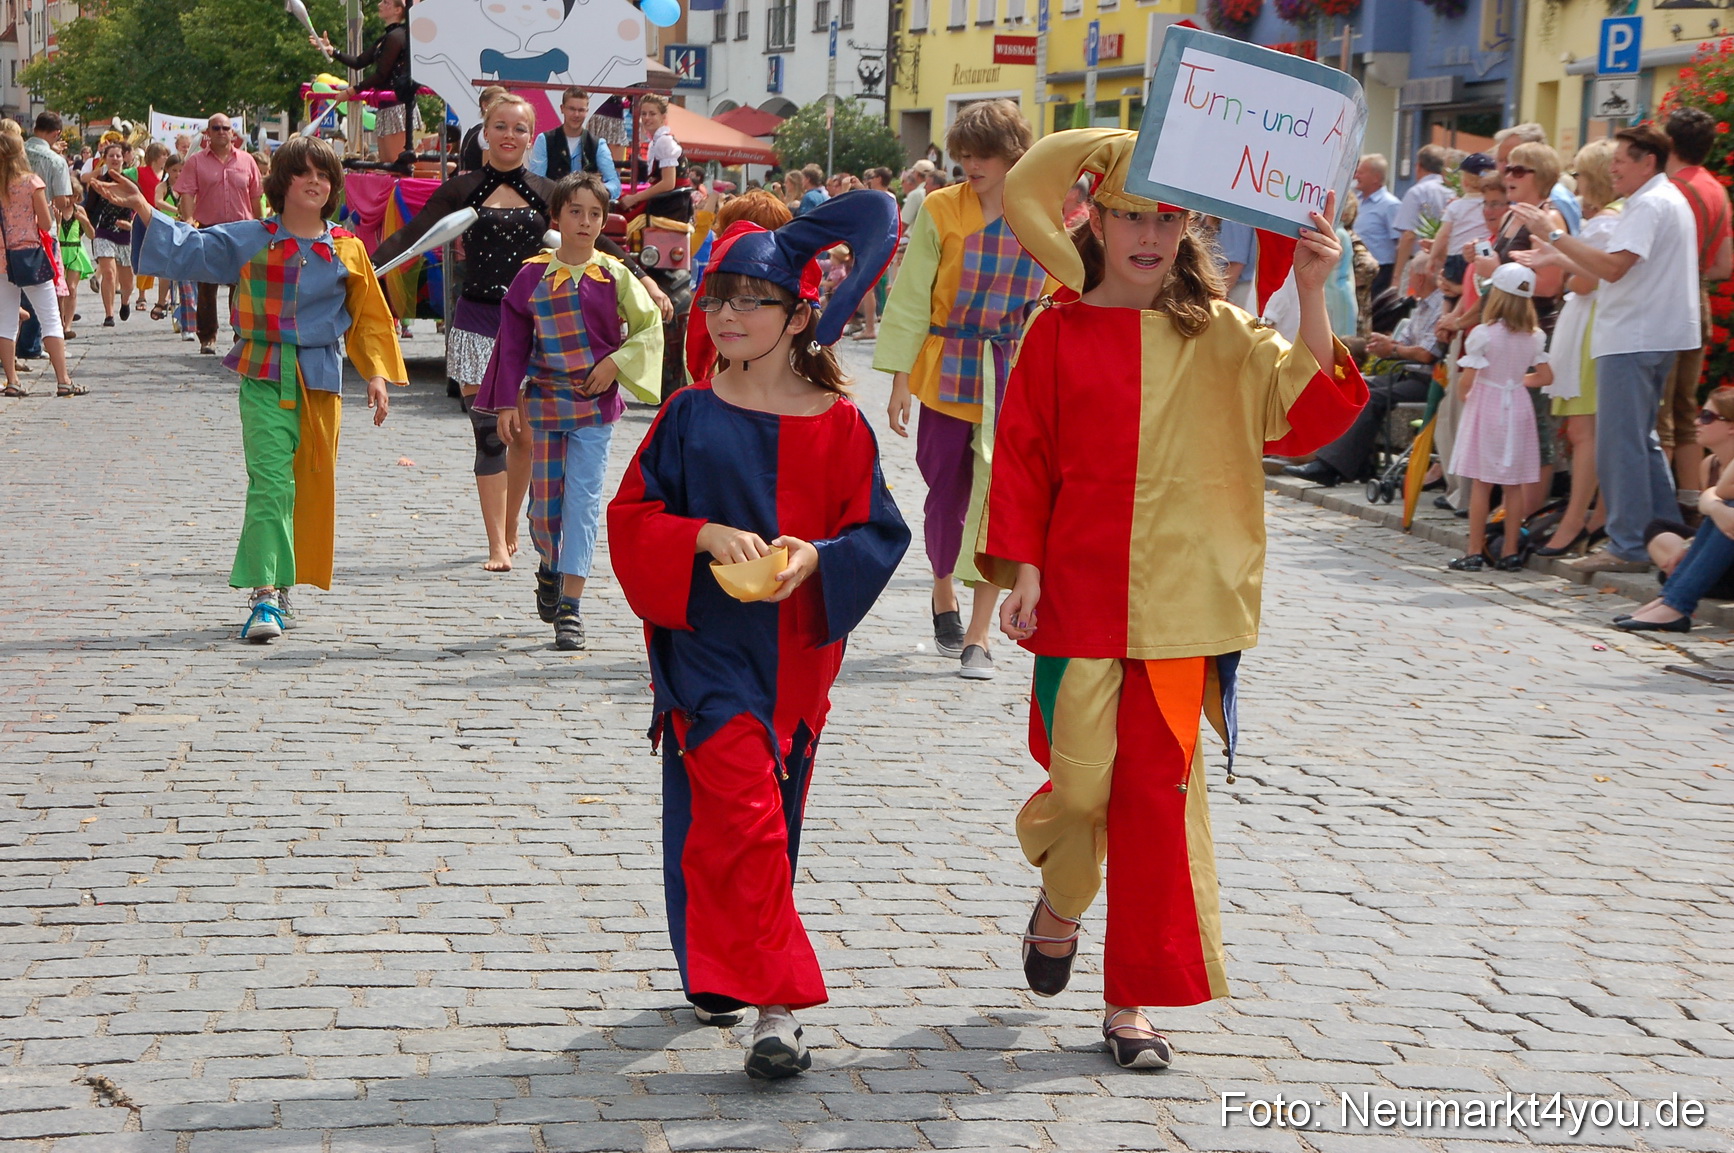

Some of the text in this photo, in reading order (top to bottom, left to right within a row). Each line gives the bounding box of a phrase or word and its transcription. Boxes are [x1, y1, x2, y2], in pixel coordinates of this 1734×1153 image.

[995, 43, 1038, 57] WISSMAC
[1605, 24, 1634, 69] P
[952, 63, 1001, 86] Restaurant
[727, 148, 766, 161] Lehmeier
